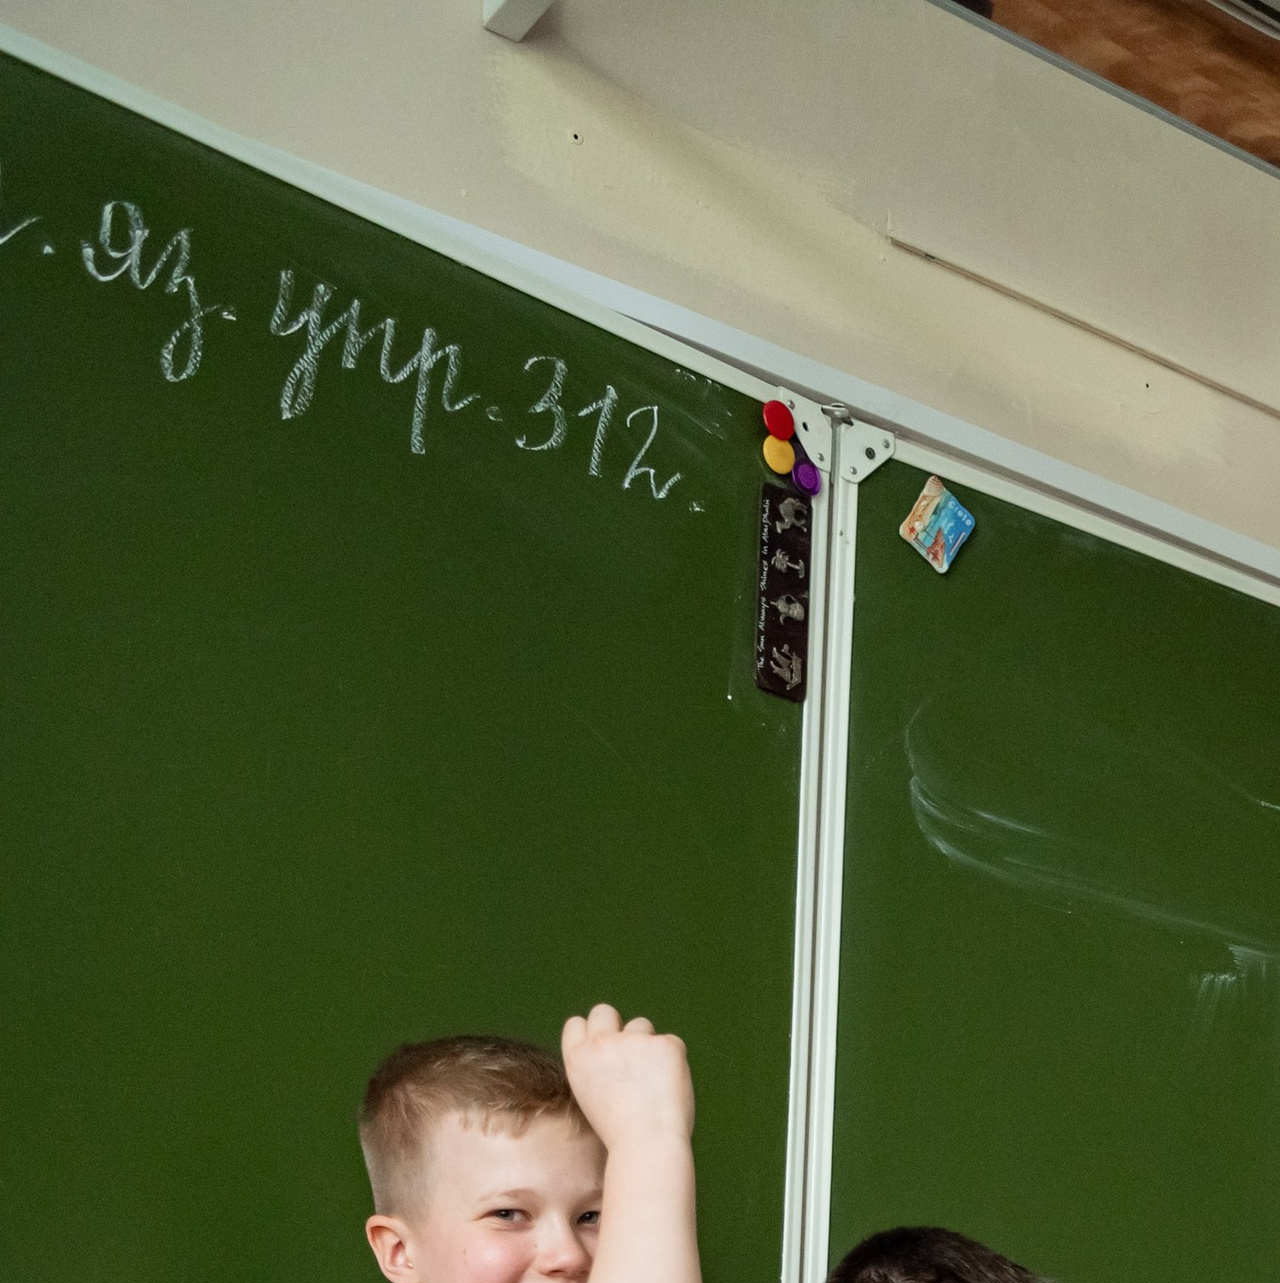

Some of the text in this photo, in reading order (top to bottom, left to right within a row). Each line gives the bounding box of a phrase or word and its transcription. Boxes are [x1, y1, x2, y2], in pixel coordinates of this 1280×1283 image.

[270, 269, 503, 455] упр.
[515, 355, 705, 512] 312.
[758, 597, 769, 632] Always
